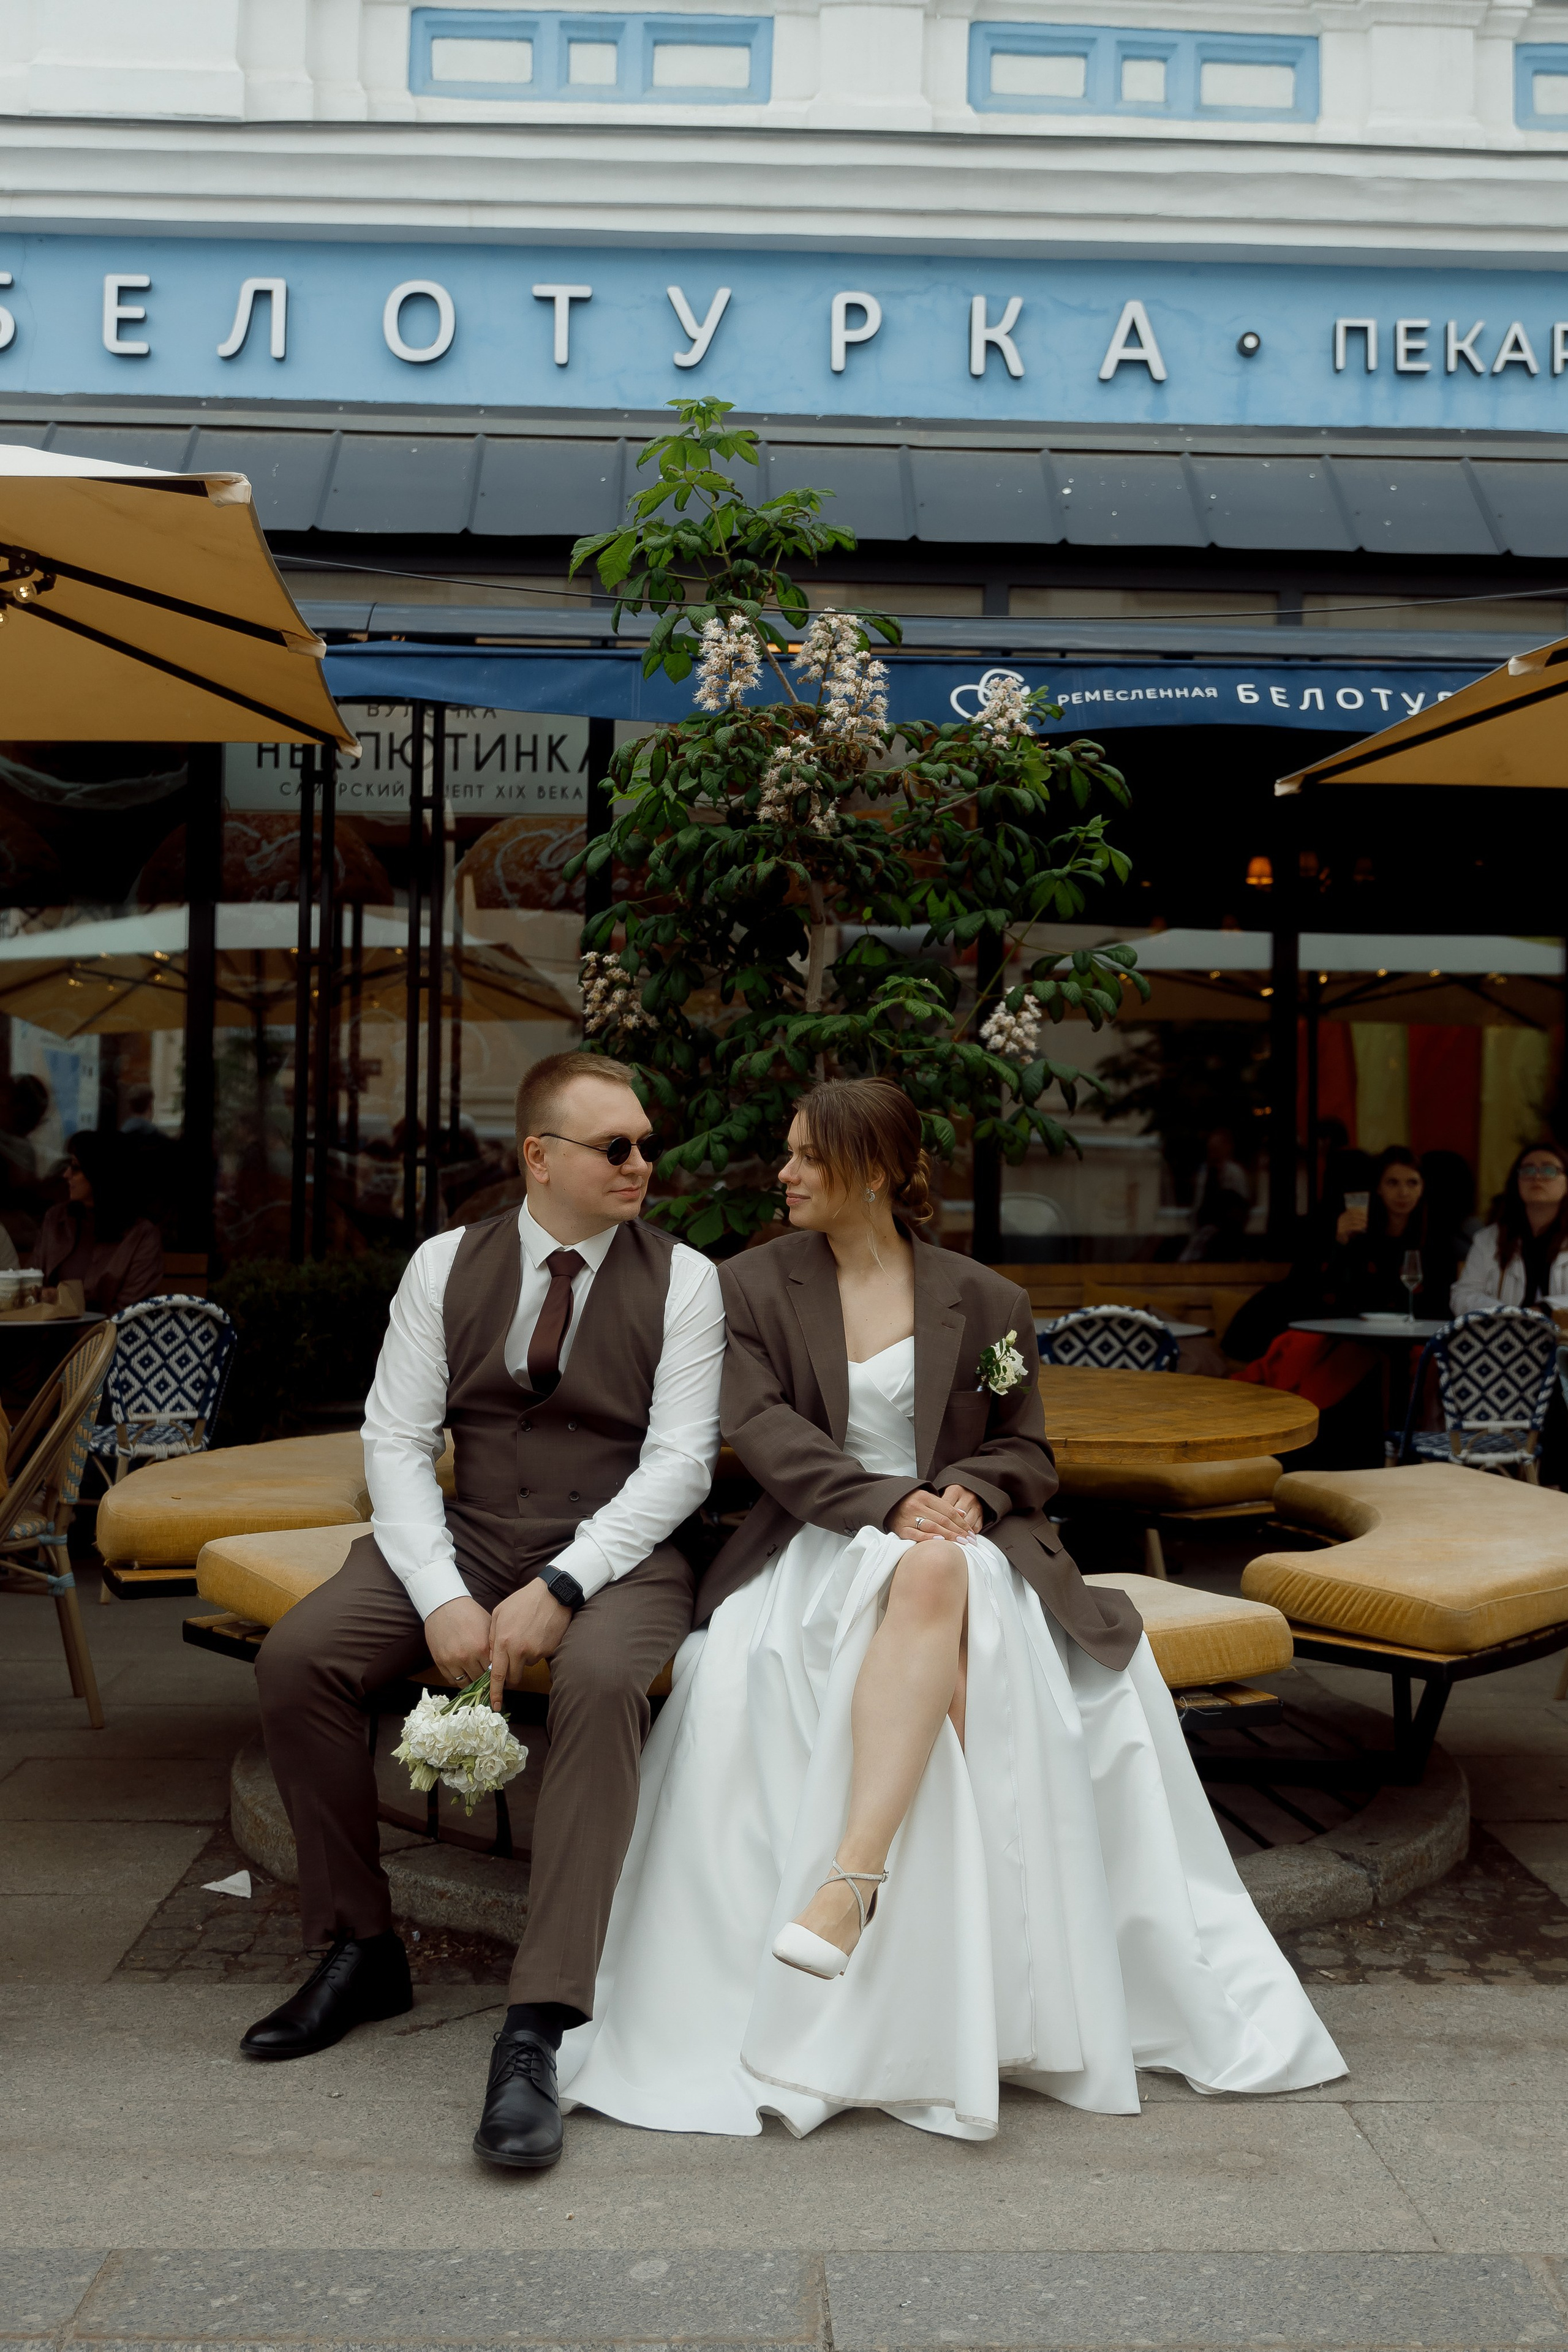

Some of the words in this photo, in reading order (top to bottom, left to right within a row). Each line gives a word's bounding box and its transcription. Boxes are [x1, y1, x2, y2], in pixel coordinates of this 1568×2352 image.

[1057, 686, 1218, 707] РЕМЕСЛЕННАЯ
[257, 731, 589, 773] НЕЛЮТИНК
[279, 780, 405, 797] СРСКИЙ
[537, 785, 583, 799] ВЕКА
